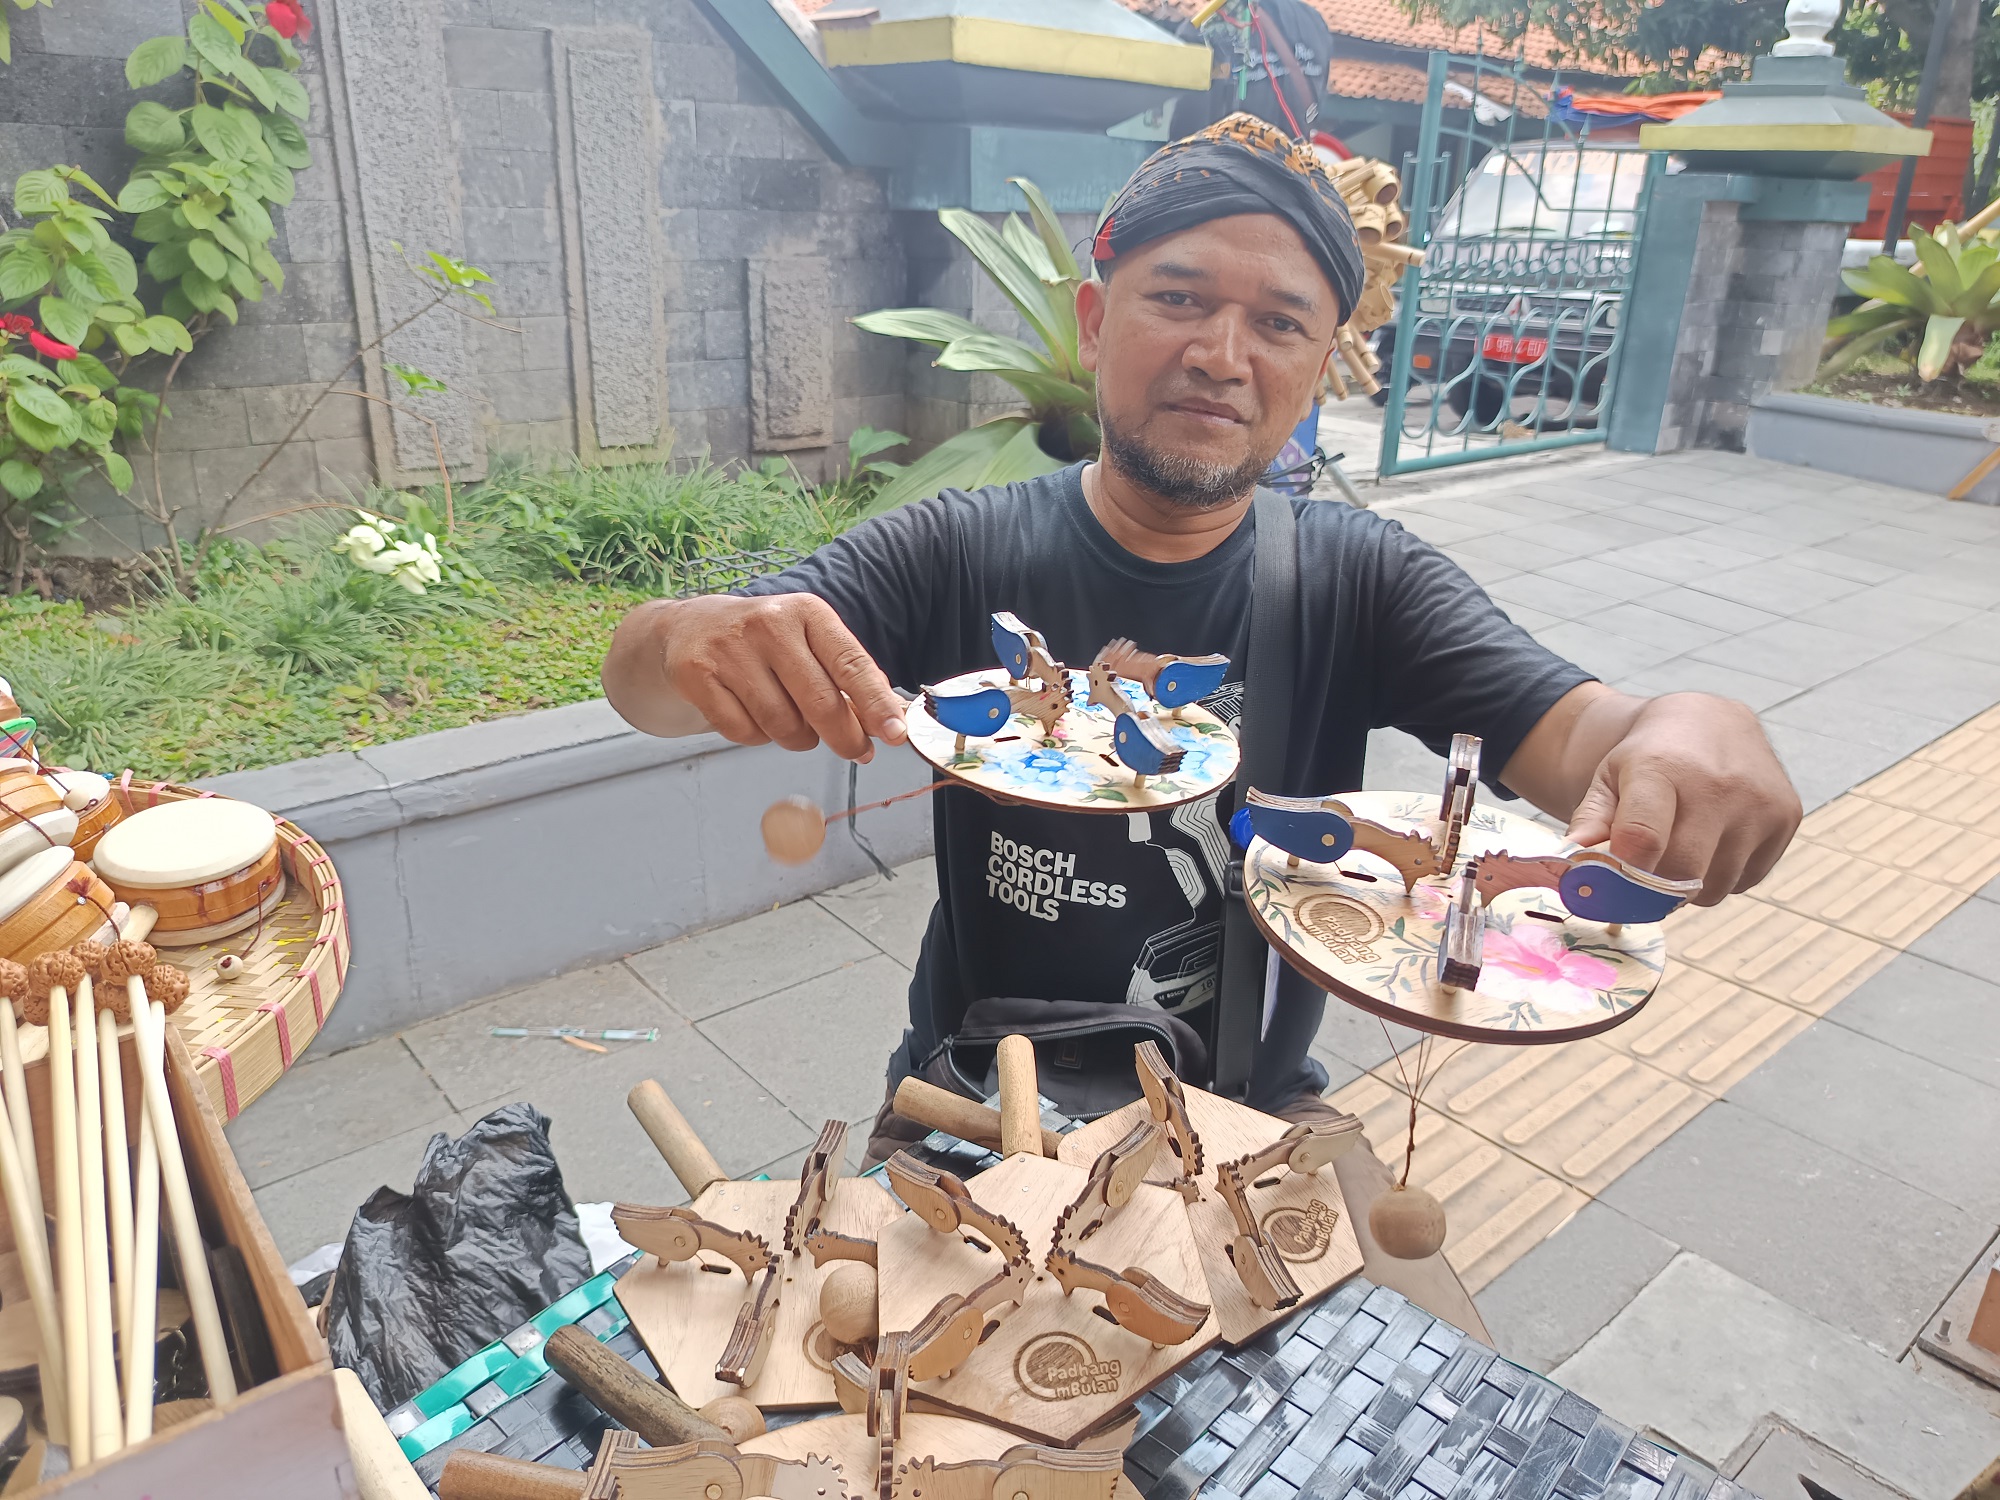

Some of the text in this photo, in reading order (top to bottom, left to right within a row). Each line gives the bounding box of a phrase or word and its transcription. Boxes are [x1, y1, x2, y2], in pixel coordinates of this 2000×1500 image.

[990, 830, 1076, 877] BOSCH
[985, 874, 1060, 922] TOOLS
[988, 854, 1127, 909] CORDLESS
[1320, 915, 1382, 963] Padhang
[1166, 989, 1185, 998] BOSCH
[1201, 978, 1216, 992] 18
[1294, 1199, 1328, 1245] Padhang
[1047, 1360, 1122, 1382] Padhang
